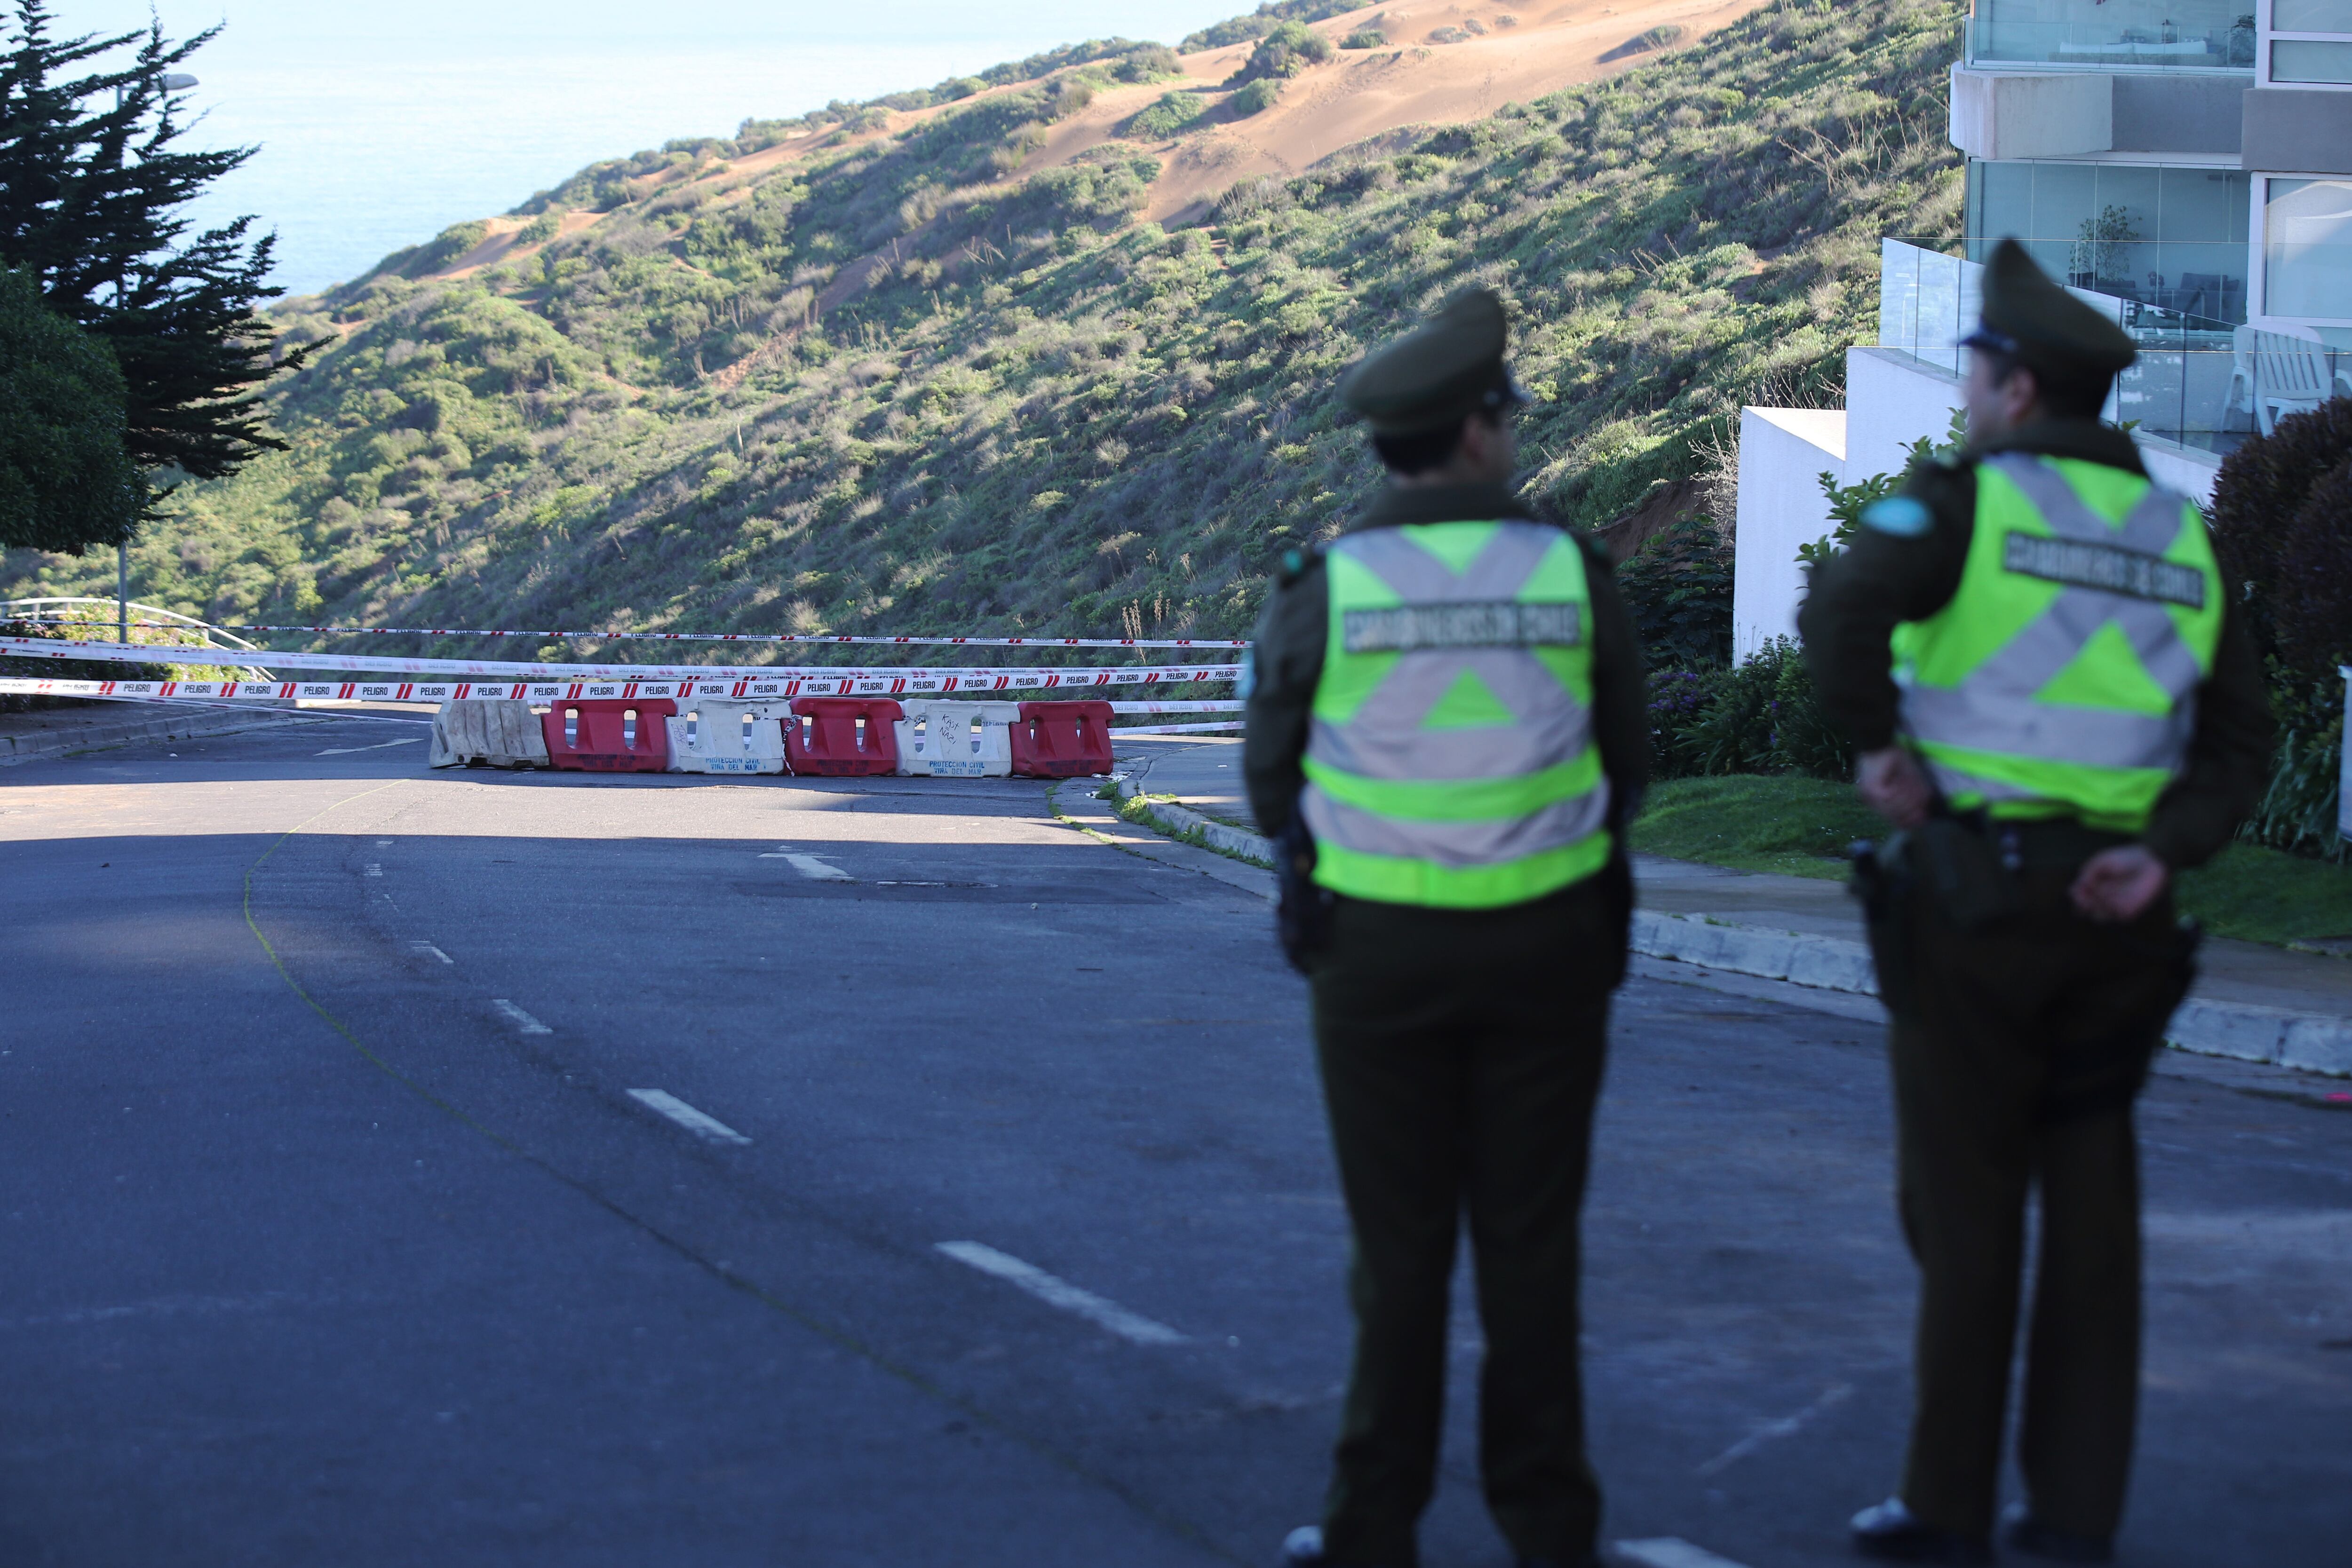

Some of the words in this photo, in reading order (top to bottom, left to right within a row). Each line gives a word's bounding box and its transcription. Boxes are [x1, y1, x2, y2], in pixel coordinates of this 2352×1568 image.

[245, 686, 271, 694] PELIGRO
[304, 686, 330, 695] PELIGRO
[421, 687, 445, 696] PELIGRO
[645, 686, 669, 695] PELIGRO
[964, 679, 987, 688] PELIGRO
[939, 727, 956, 744] NAZI
